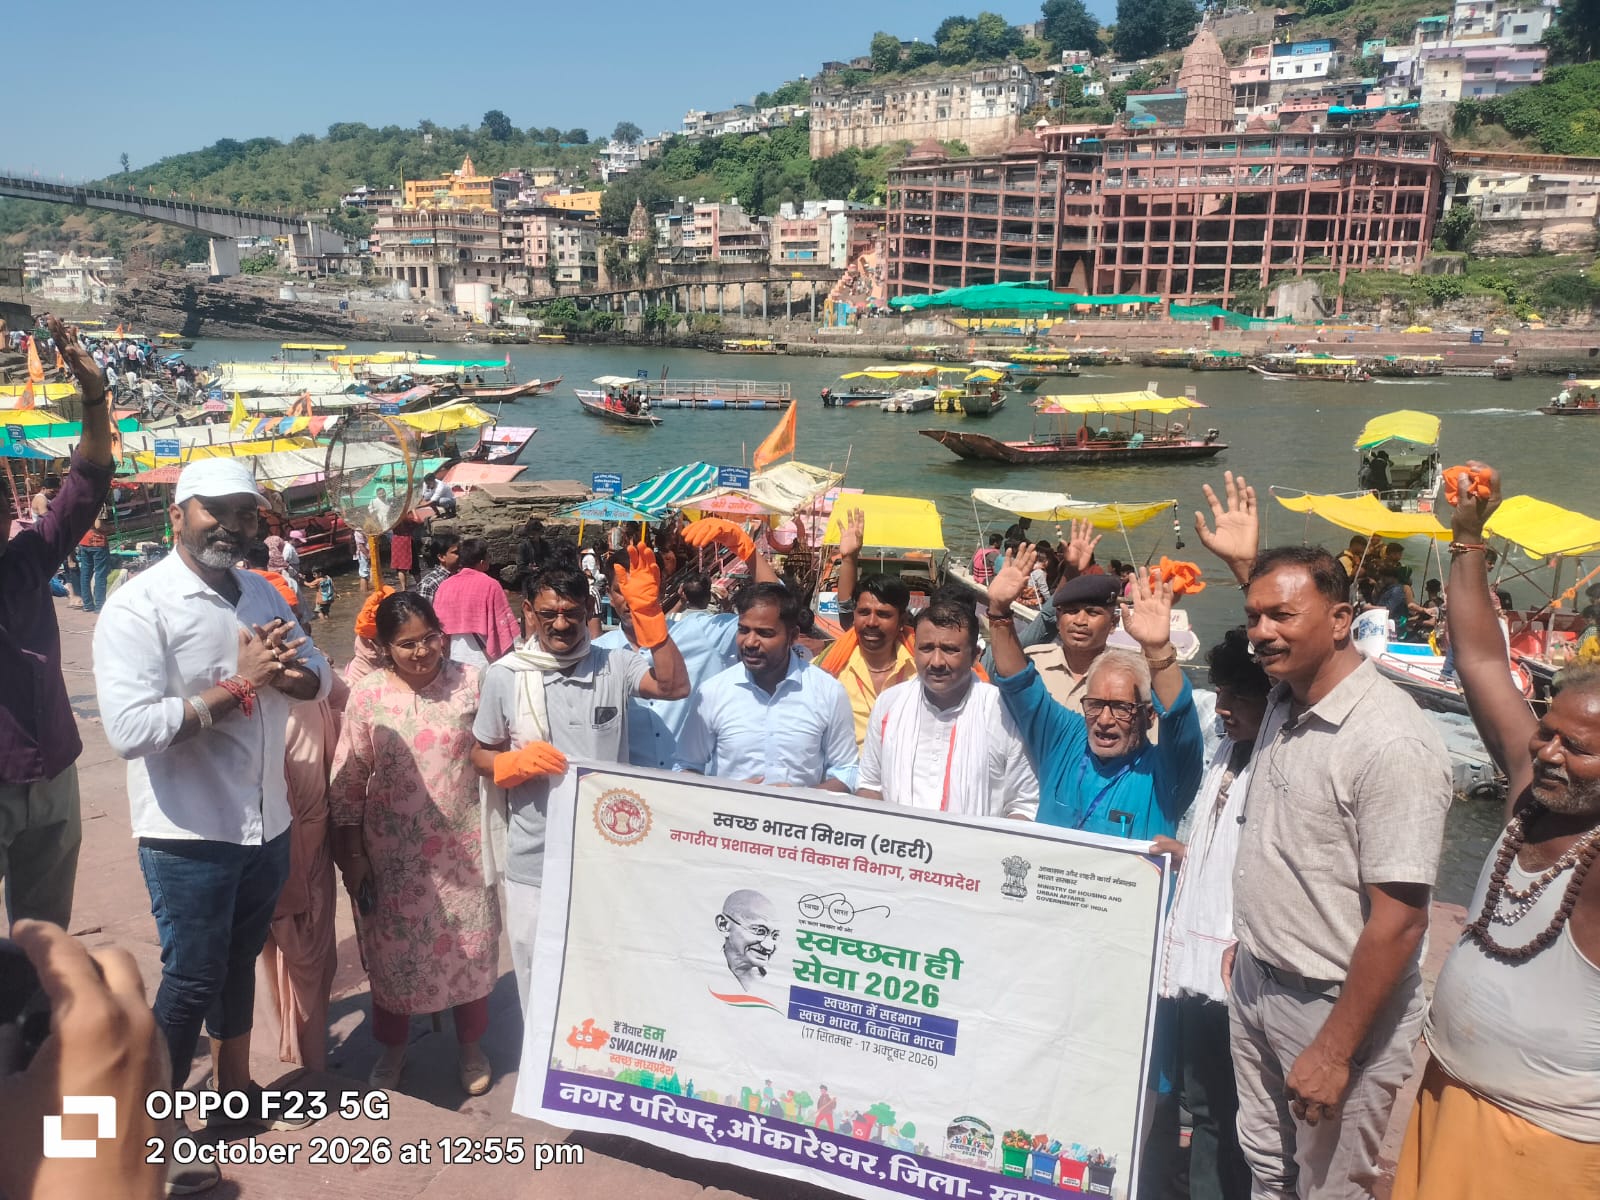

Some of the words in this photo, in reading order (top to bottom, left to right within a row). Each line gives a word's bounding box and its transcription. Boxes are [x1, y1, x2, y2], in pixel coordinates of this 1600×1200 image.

[713, 812, 759, 831] स्वच्छ
[762, 819, 808, 840] भारत
[811, 822, 867, 849] मिशन
[871, 833, 934, 863] (शहरी)
[670, 829, 718, 848] नगरीय
[721, 836, 774, 857] प्रशासन
[777, 845, 799, 861] एवं
[801, 847, 851, 870] विकास
[853, 855, 905, 881] विभाग,
[909, 868, 981, 892] मध्यप्रदेश
[1036, 889, 1059, 898] URBAN
[1060, 893, 1086, 902] AFFAIRS
[1036, 895, 1080, 908] GOVERNMENT
[1091, 905, 1108, 913] INDIA
[1037, 883, 1067, 893] MINISTRY
[1077, 890, 1107, 900] HOUSING
[1108, 895, 1123, 903] AND
[796, 929, 921, 971] स्वच्छता
[924, 947, 964, 981] ही
[792, 954, 860, 991] सेवा
[864, 972, 940, 1009] 2026
[799, 1009, 826, 1023] स्वच्छ
[829, 1015, 862, 1034] भारत,
[865, 1021, 910, 1044] विकसित
[913, 1036, 944, 1051] भारत
[824, 997, 863, 1014] स्वच्छता
[866, 1003, 878, 1018] में
[879, 1008, 922, 1028] सहभाग
[609, 1037, 658, 1058] SWACHH
[659, 1048, 678, 1062] MP
[621, 1021, 642, 1037] तैयार
[643, 1024, 666, 1043] हम
[801, 1025, 815, 1039] (17
[816, 1029, 853, 1048] सितम्बर
[861, 1041, 871, 1052] 17
[873, 1044, 907, 1062] अक्टूबर
[908, 1051, 938, 1069] 2026)
[634, 1058, 675, 1075] मध्यप्रदेश
[559, 1082, 625, 1111] नगर
[630, 1094, 725, 1142] परिषद्,
[726, 1114, 886, 1180] ओंकारेश्वर,
